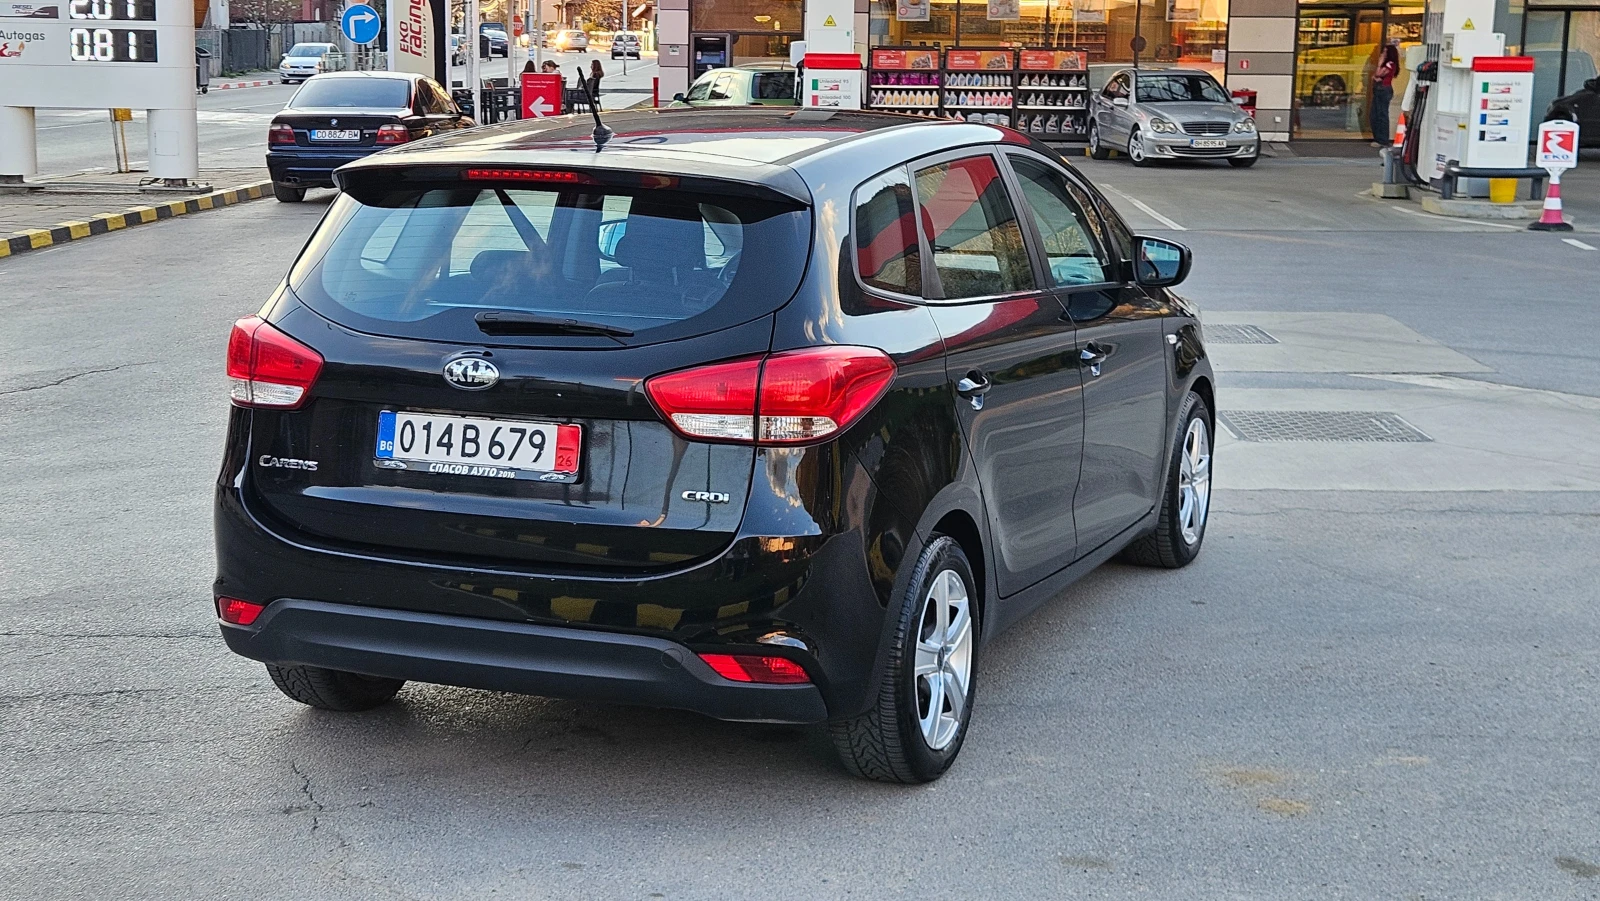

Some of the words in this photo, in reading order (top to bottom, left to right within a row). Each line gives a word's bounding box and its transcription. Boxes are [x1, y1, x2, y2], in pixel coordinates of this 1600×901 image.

[0, 30, 45, 43] Autogas
[71, 28, 137, 61] 0.81
[400, 21, 409, 53] EKO
[451, 362, 491, 383] KIA
[379, 440, 394, 452] BG
[399, 419, 547, 464] 014B679
[258, 454, 319, 471] CARENS
[557, 454, 574, 467] 26
[429, 463, 469, 475] СПАСОВ
[470, 466, 497, 477] АУТО
[498, 470, 516, 479] 2016
